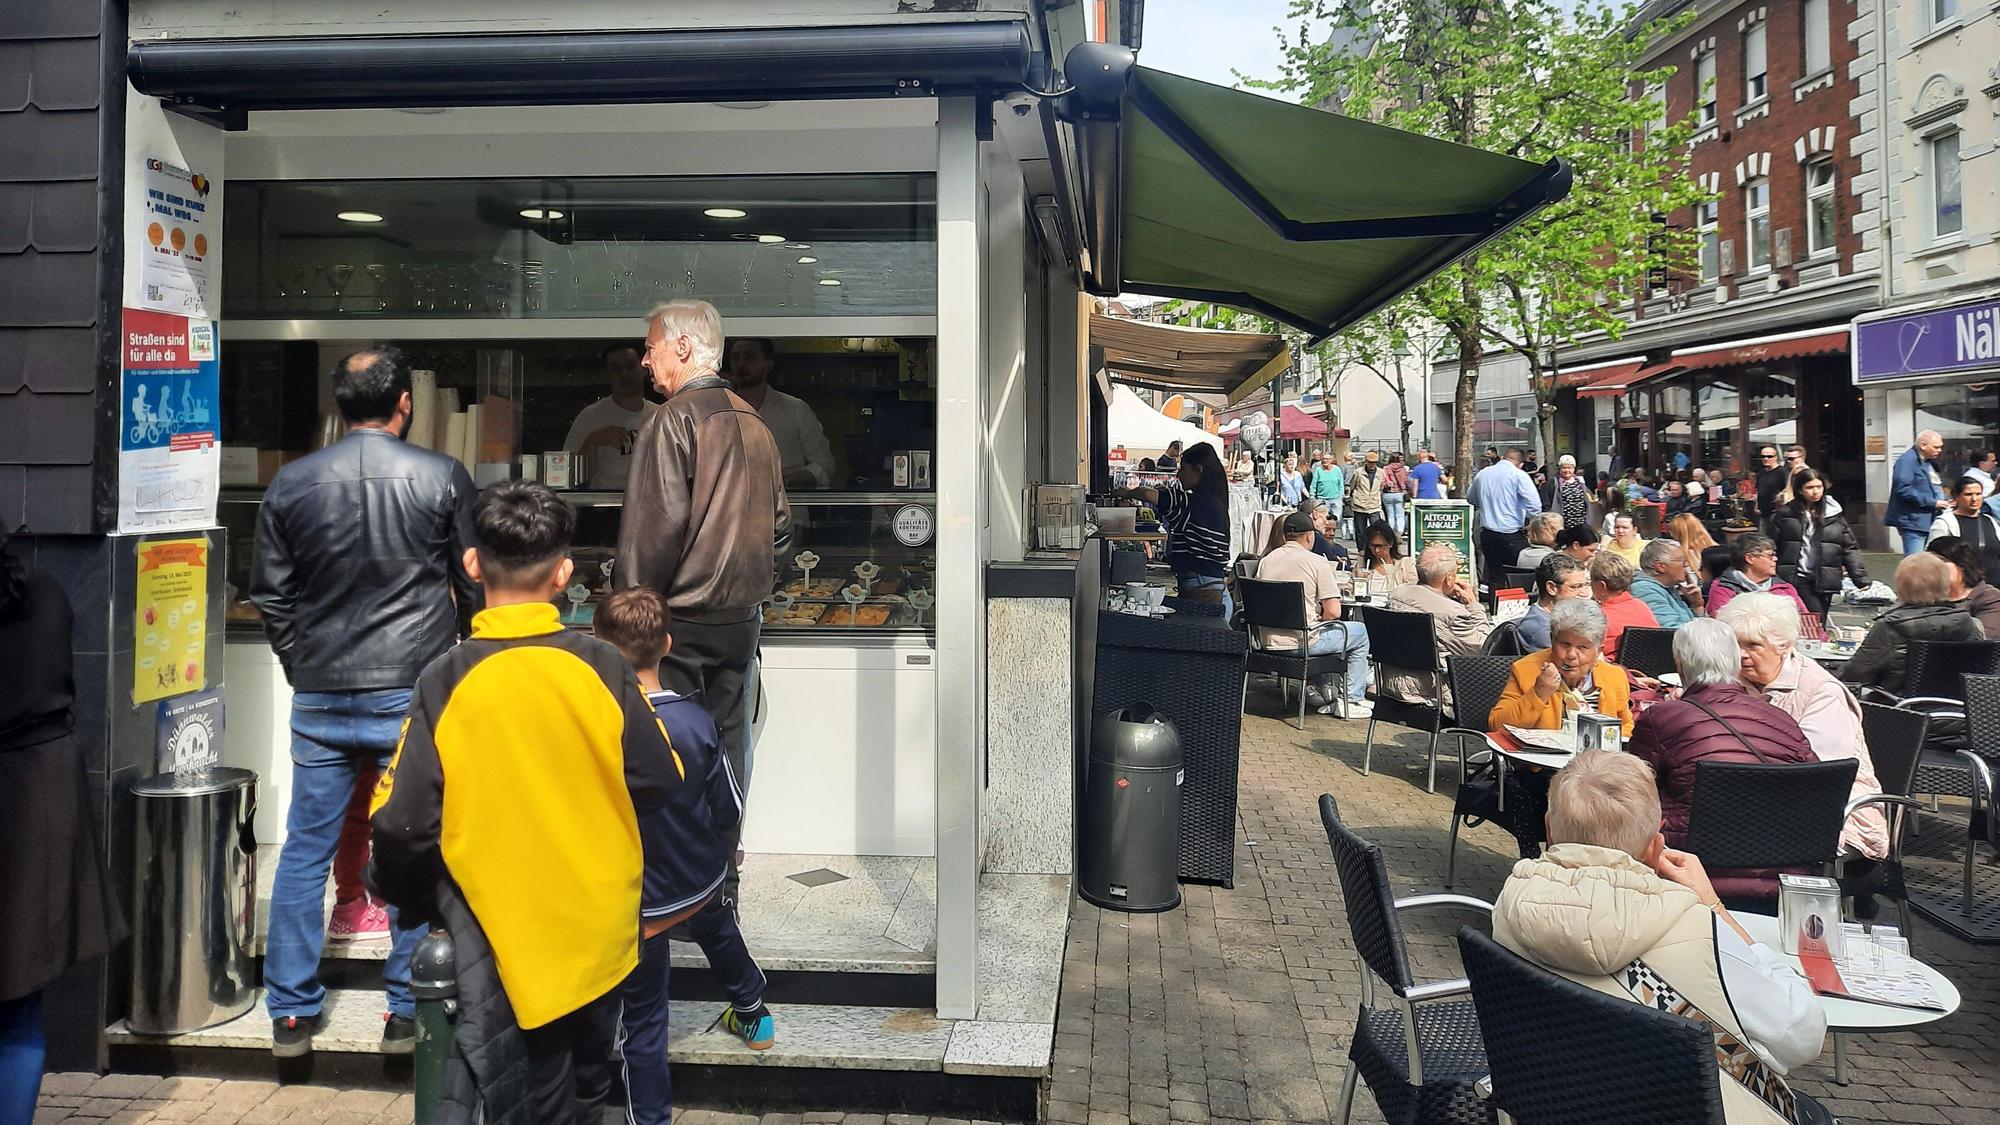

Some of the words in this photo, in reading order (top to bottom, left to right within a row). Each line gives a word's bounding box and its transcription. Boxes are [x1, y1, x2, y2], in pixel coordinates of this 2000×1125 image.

[149, 188, 164, 201] WIR
[166, 193, 184, 206] SIND
[185, 199, 205, 212] KURZ
[155, 203, 172, 216] MAL
[174, 208, 191, 221] WEG
[129, 332, 165, 346] Straßen
[166, 333, 185, 346] sind
[130, 348, 143, 362] für
[145, 349, 162, 361] alle
[164, 349, 176, 361] da
[1427, 521, 1459, 529] ANKAUF
[167, 712, 214, 752] Dünnwalder
